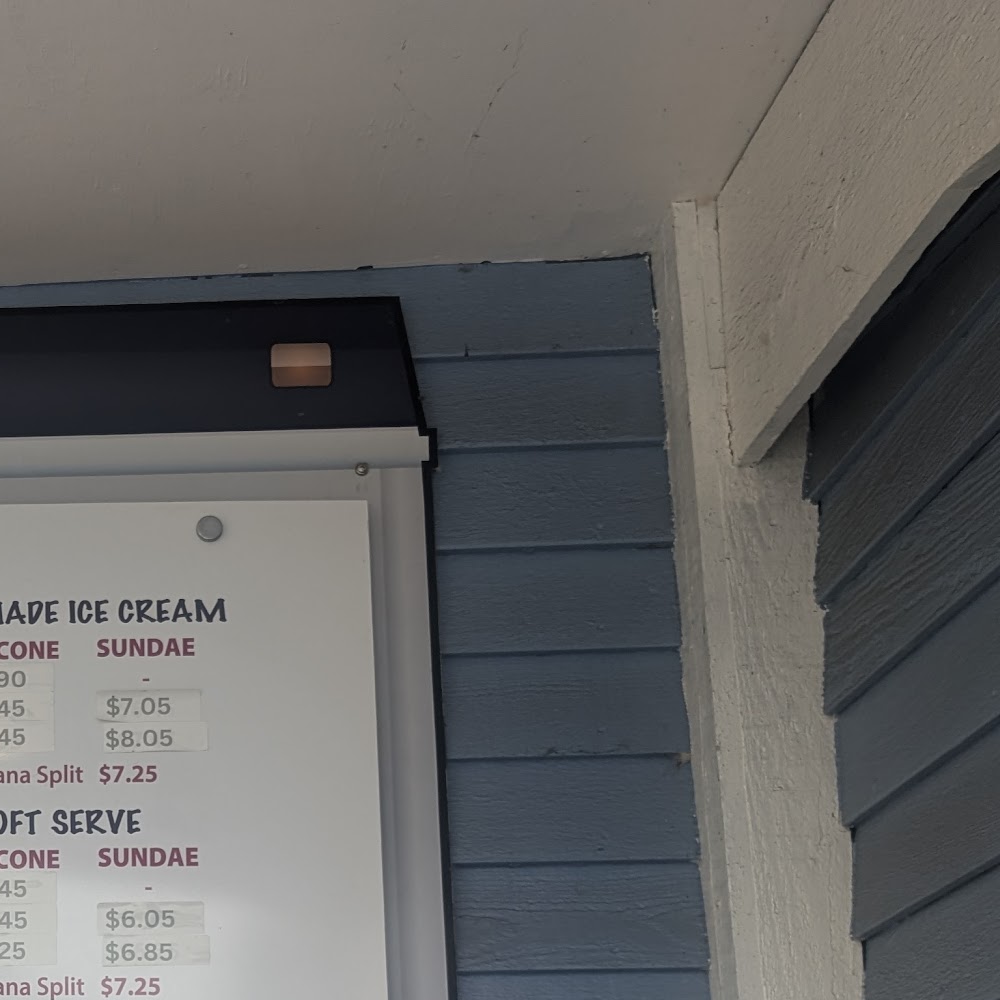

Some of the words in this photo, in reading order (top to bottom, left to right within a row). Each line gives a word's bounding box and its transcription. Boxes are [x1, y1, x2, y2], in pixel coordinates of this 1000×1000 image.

[69, 600, 108, 623] ICE
[119, 598, 227, 623] CREAM
[97, 638, 194, 657] SUNDAE
[107, 696, 170, 718] $7.05
[106, 728, 172, 750] $8.05
[37, 765, 83, 788] Split
[100, 764, 157, 785] $7.25
[51, 809, 141, 834] SERVE
[106, 908, 174, 931] $6.05
[106, 941, 172, 963] $6.85
